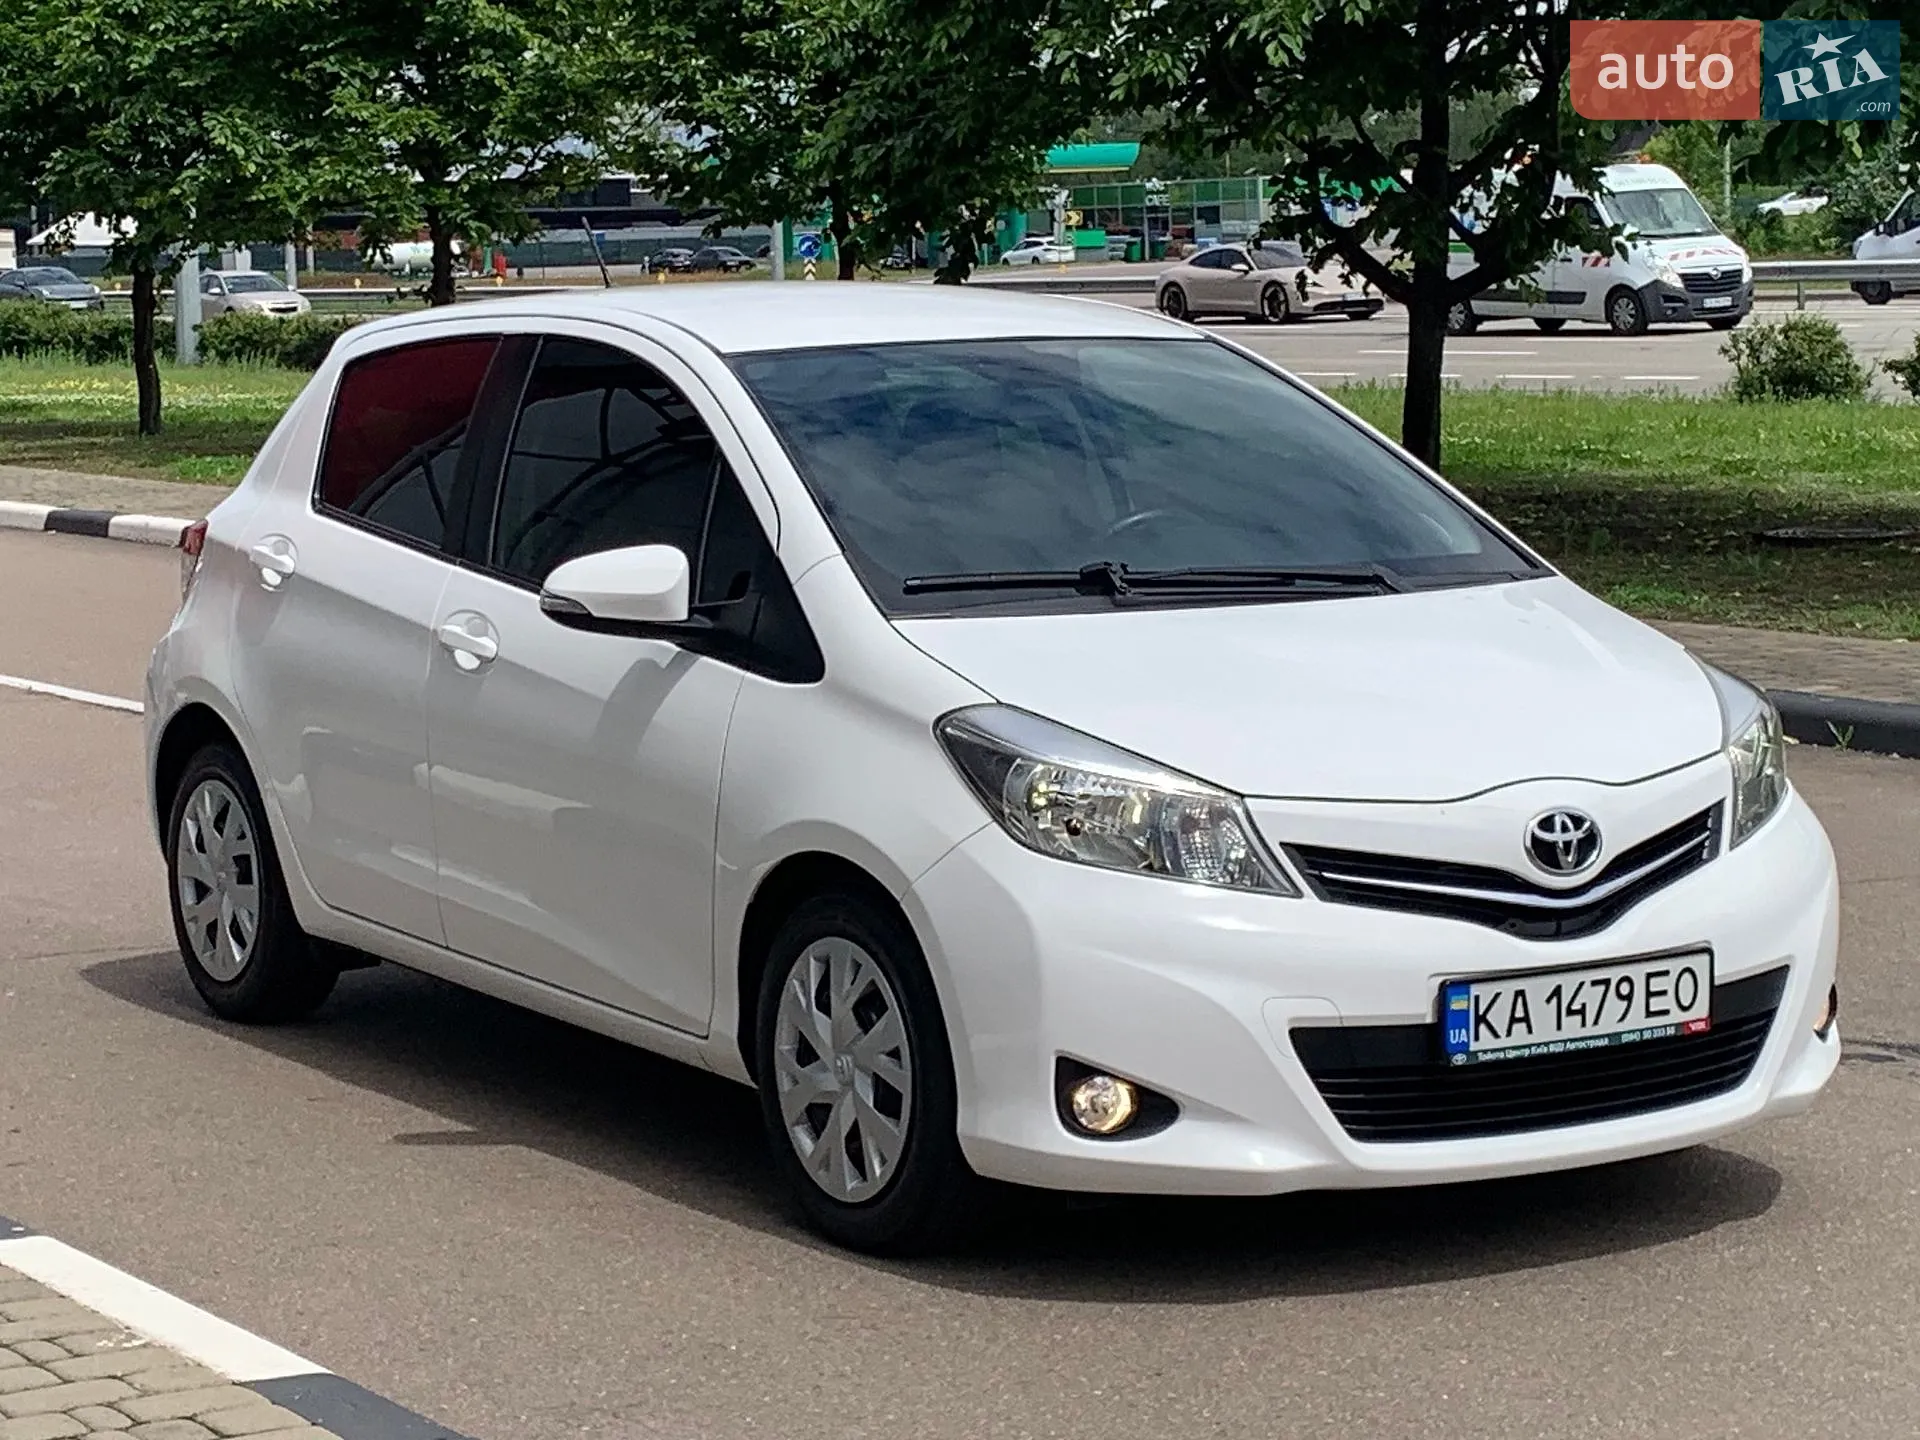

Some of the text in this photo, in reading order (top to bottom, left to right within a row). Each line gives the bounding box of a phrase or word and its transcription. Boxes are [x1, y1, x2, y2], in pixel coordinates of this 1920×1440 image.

[1473, 966, 1699, 1042] KA 1479 EO
[1449, 1029, 1468, 1044] UA
